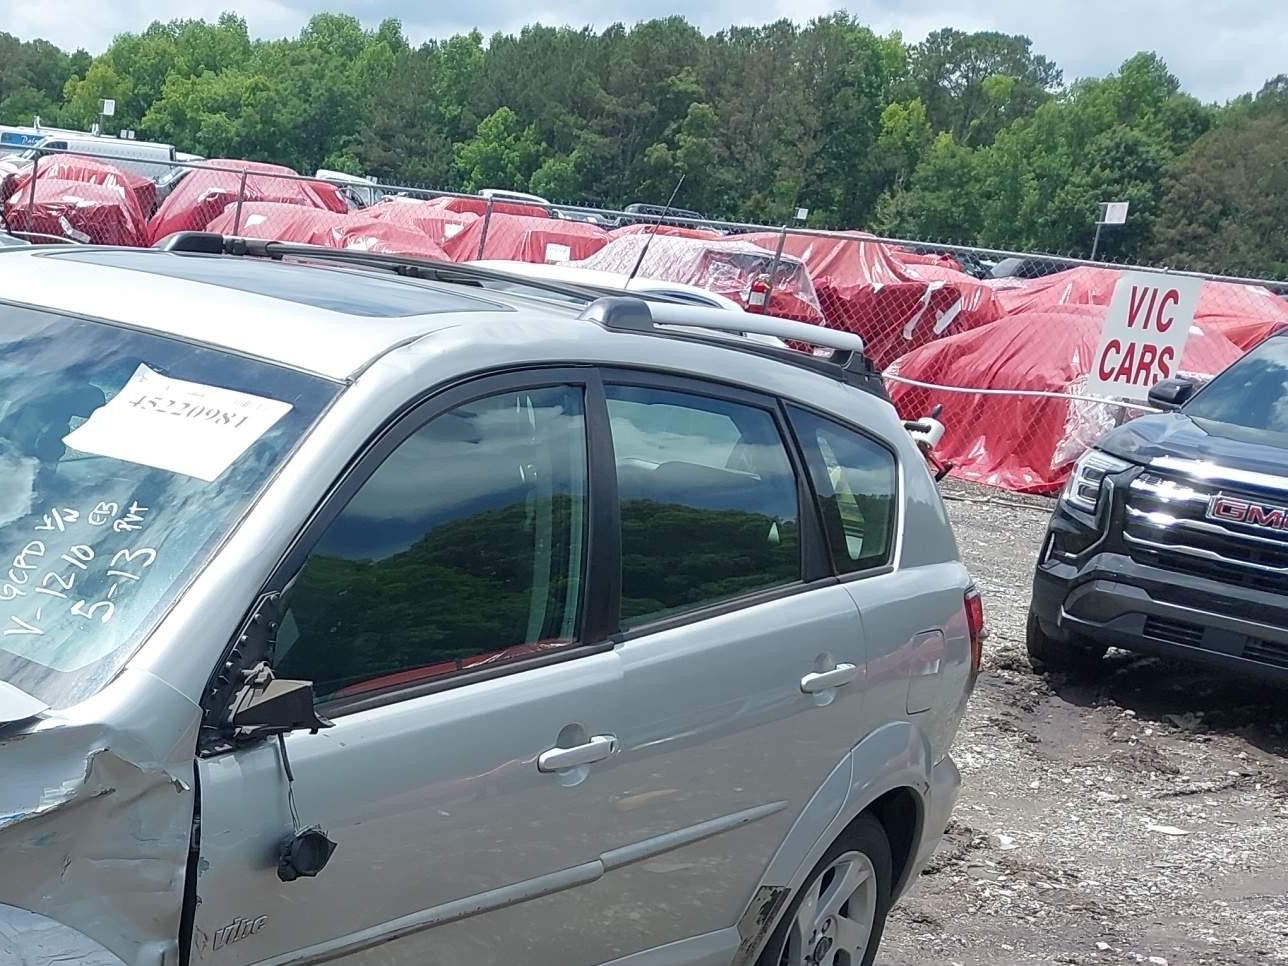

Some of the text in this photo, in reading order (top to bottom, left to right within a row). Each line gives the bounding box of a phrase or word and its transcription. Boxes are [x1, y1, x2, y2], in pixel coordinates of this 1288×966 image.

[1127, 285, 1179, 333] VIC
[1098, 338, 1175, 387] CARS
[128, 394, 249, 429] 45220981
[1214, 499, 1288, 531] GM
